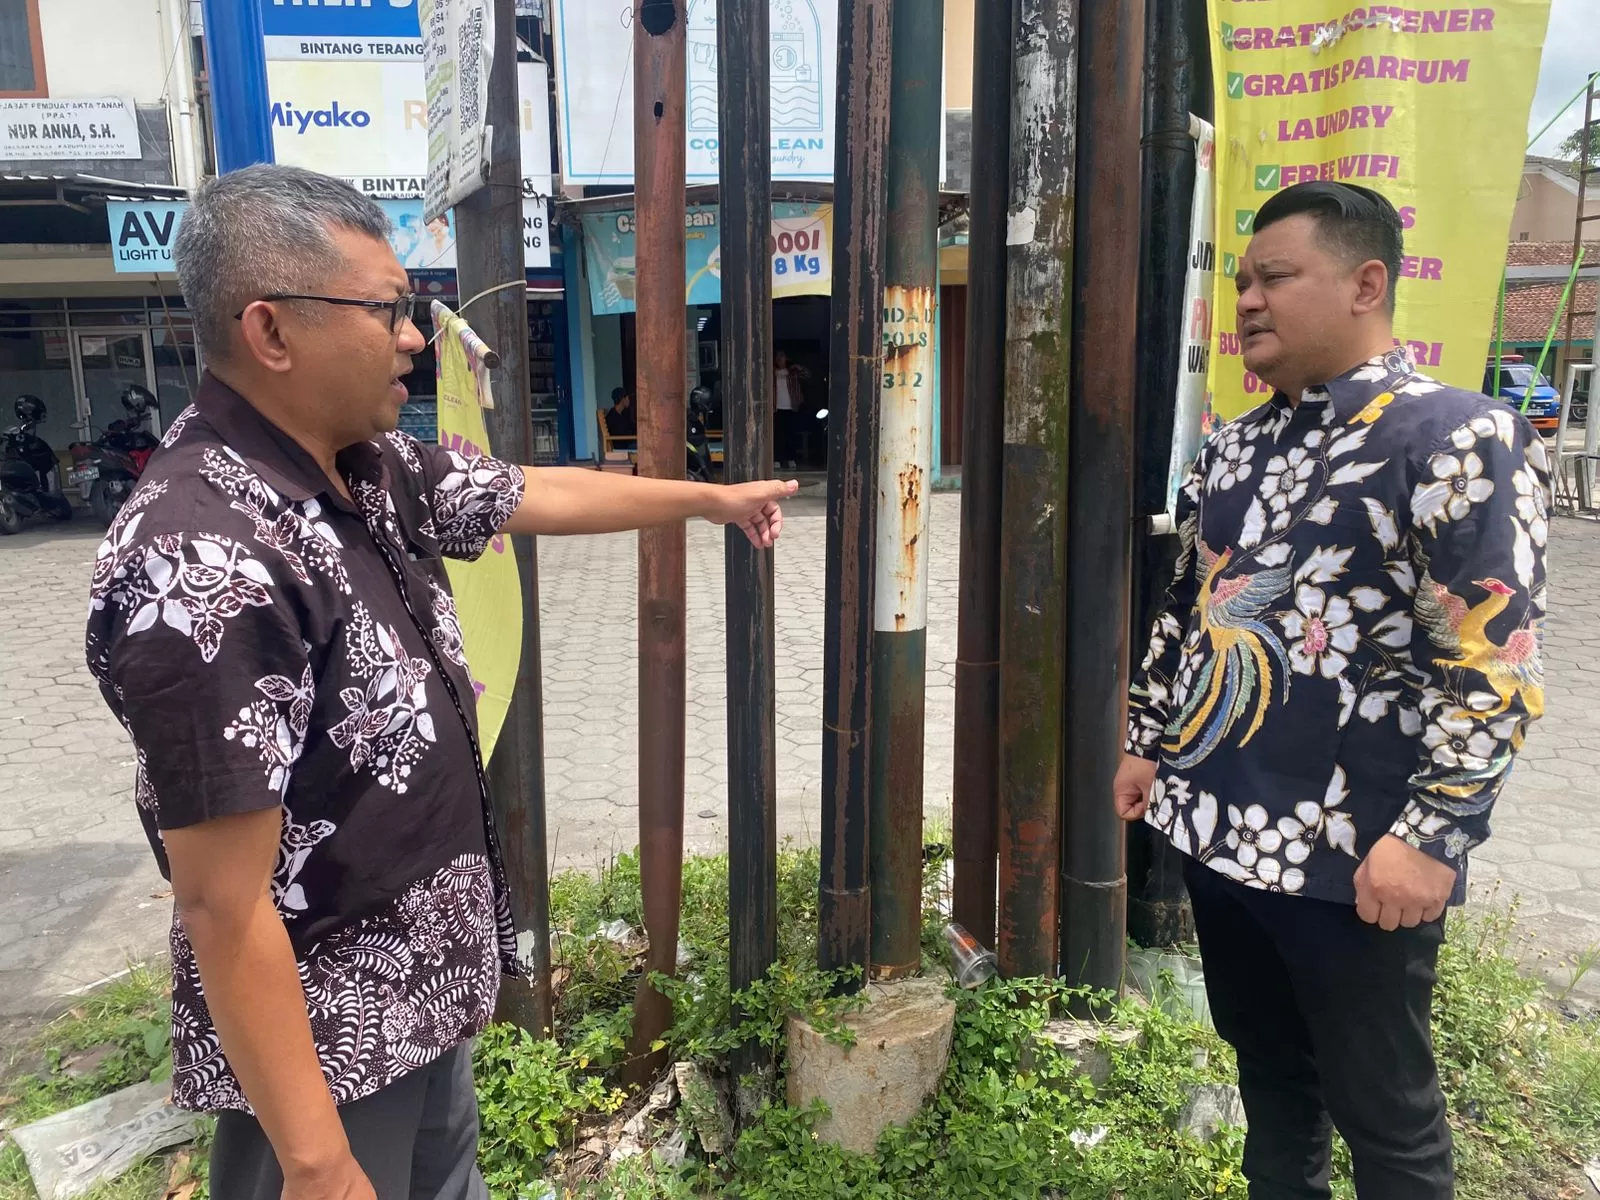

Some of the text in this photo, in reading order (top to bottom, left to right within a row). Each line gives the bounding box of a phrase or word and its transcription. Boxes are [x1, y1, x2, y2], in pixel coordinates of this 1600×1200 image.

[300, 43, 424, 55] BINTANG TERANG
[1243, 55, 1470, 97] GRATIS PARFUM
[8, 123, 116, 142] NUR ANNA, S.H.
[1276, 105, 1394, 142] LAUNDRY
[1280, 154, 1400, 187] FREE WIFI
[119, 249, 158, 261] LIGHT
[794, 254, 821, 275] Kg
